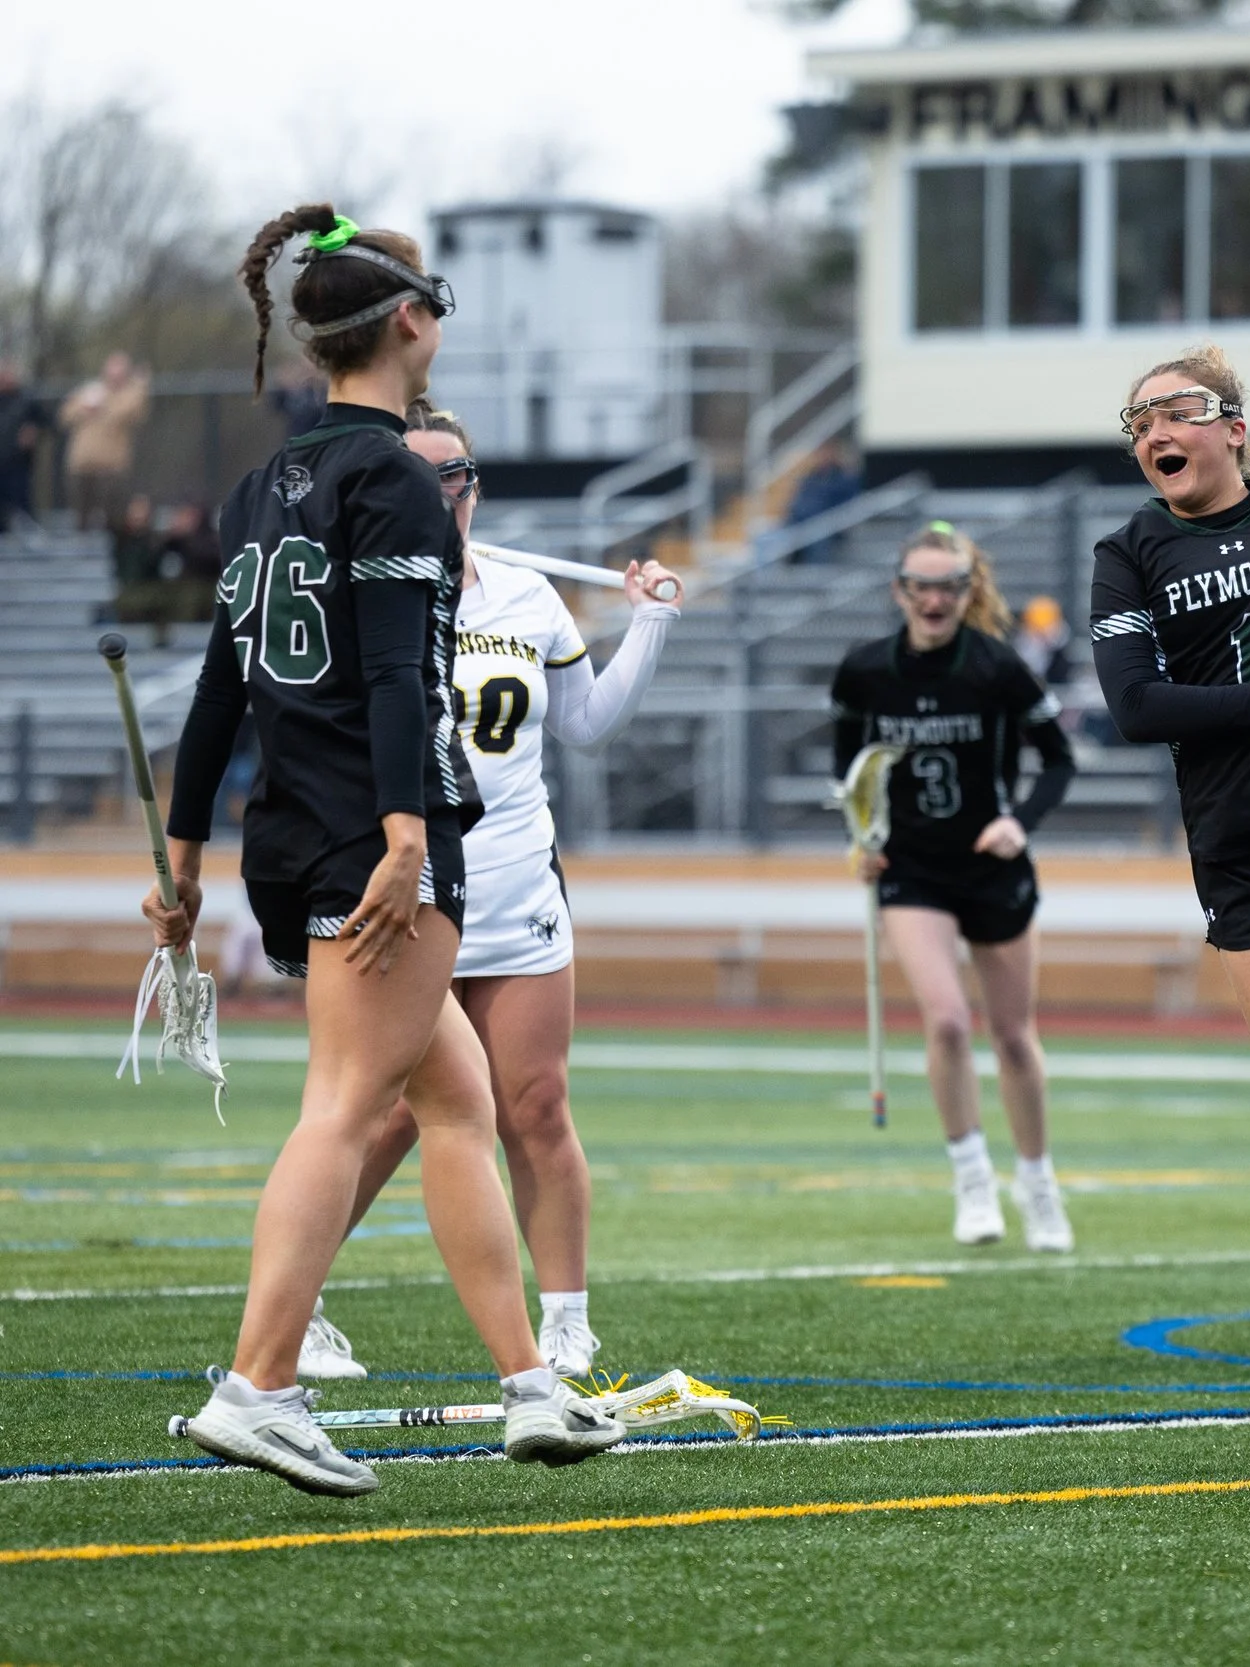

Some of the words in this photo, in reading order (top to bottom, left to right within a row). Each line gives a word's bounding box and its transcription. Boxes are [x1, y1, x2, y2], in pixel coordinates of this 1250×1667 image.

[221, 535, 333, 685] 26
[456, 632, 540, 667] NGHAM
[910, 748, 962, 819] 3
[443, 1407, 483, 1420] GAIT
